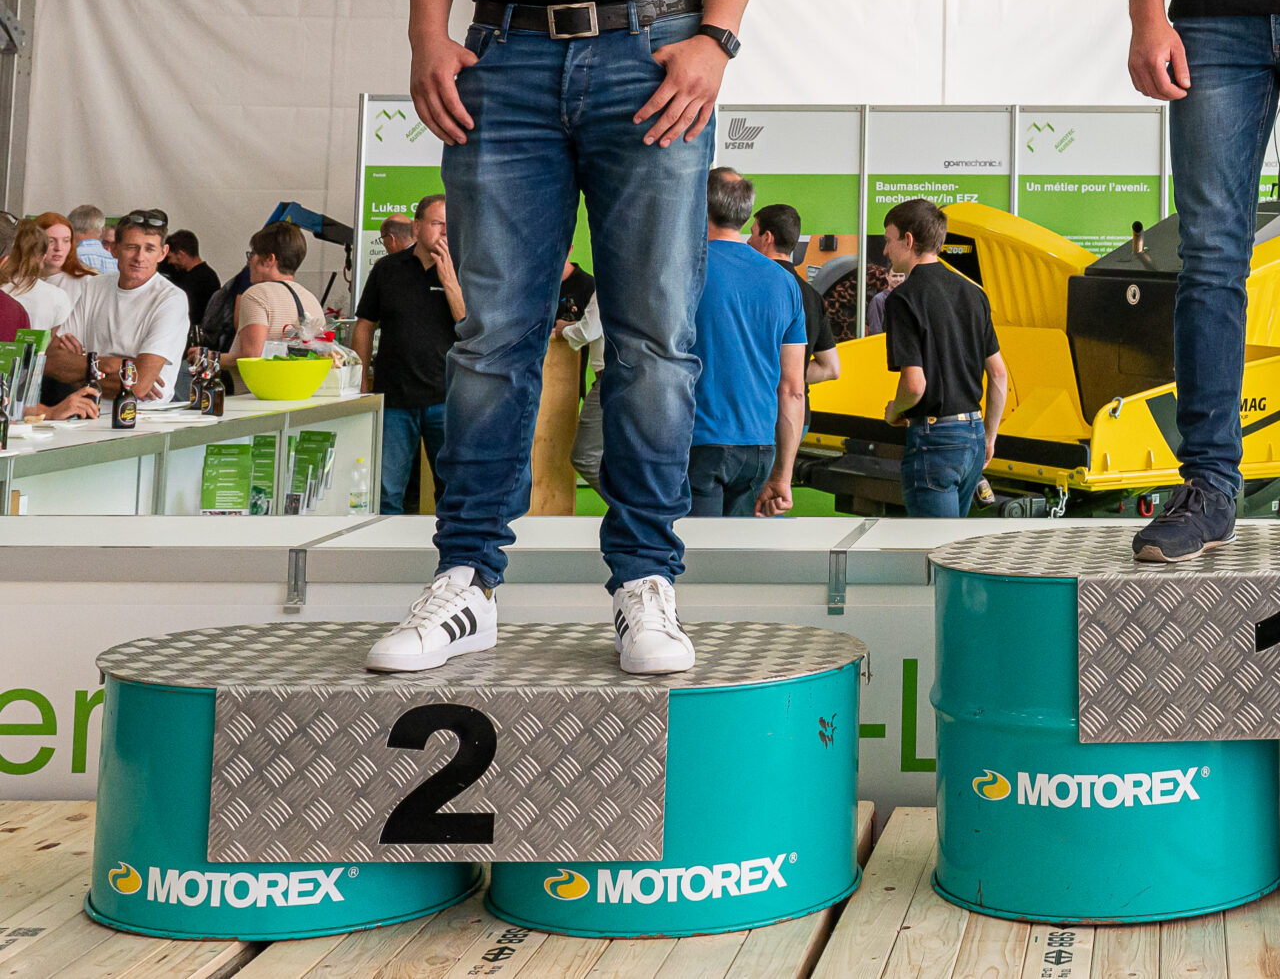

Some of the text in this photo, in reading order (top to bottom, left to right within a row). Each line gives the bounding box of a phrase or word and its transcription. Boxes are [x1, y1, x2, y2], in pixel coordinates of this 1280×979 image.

[724, 141, 754, 150] VSBM
[875, 182, 959, 192] Baumaschinen-
[1026, 181, 1151, 193] Un métier pour l'avenir.
[875, 193, 979, 204] mechaniker/in EFZ
[371, 202, 407, 213] Lukas
[1239, 397, 1268, 412] MAG
[379, 703, 498, 845] 2
